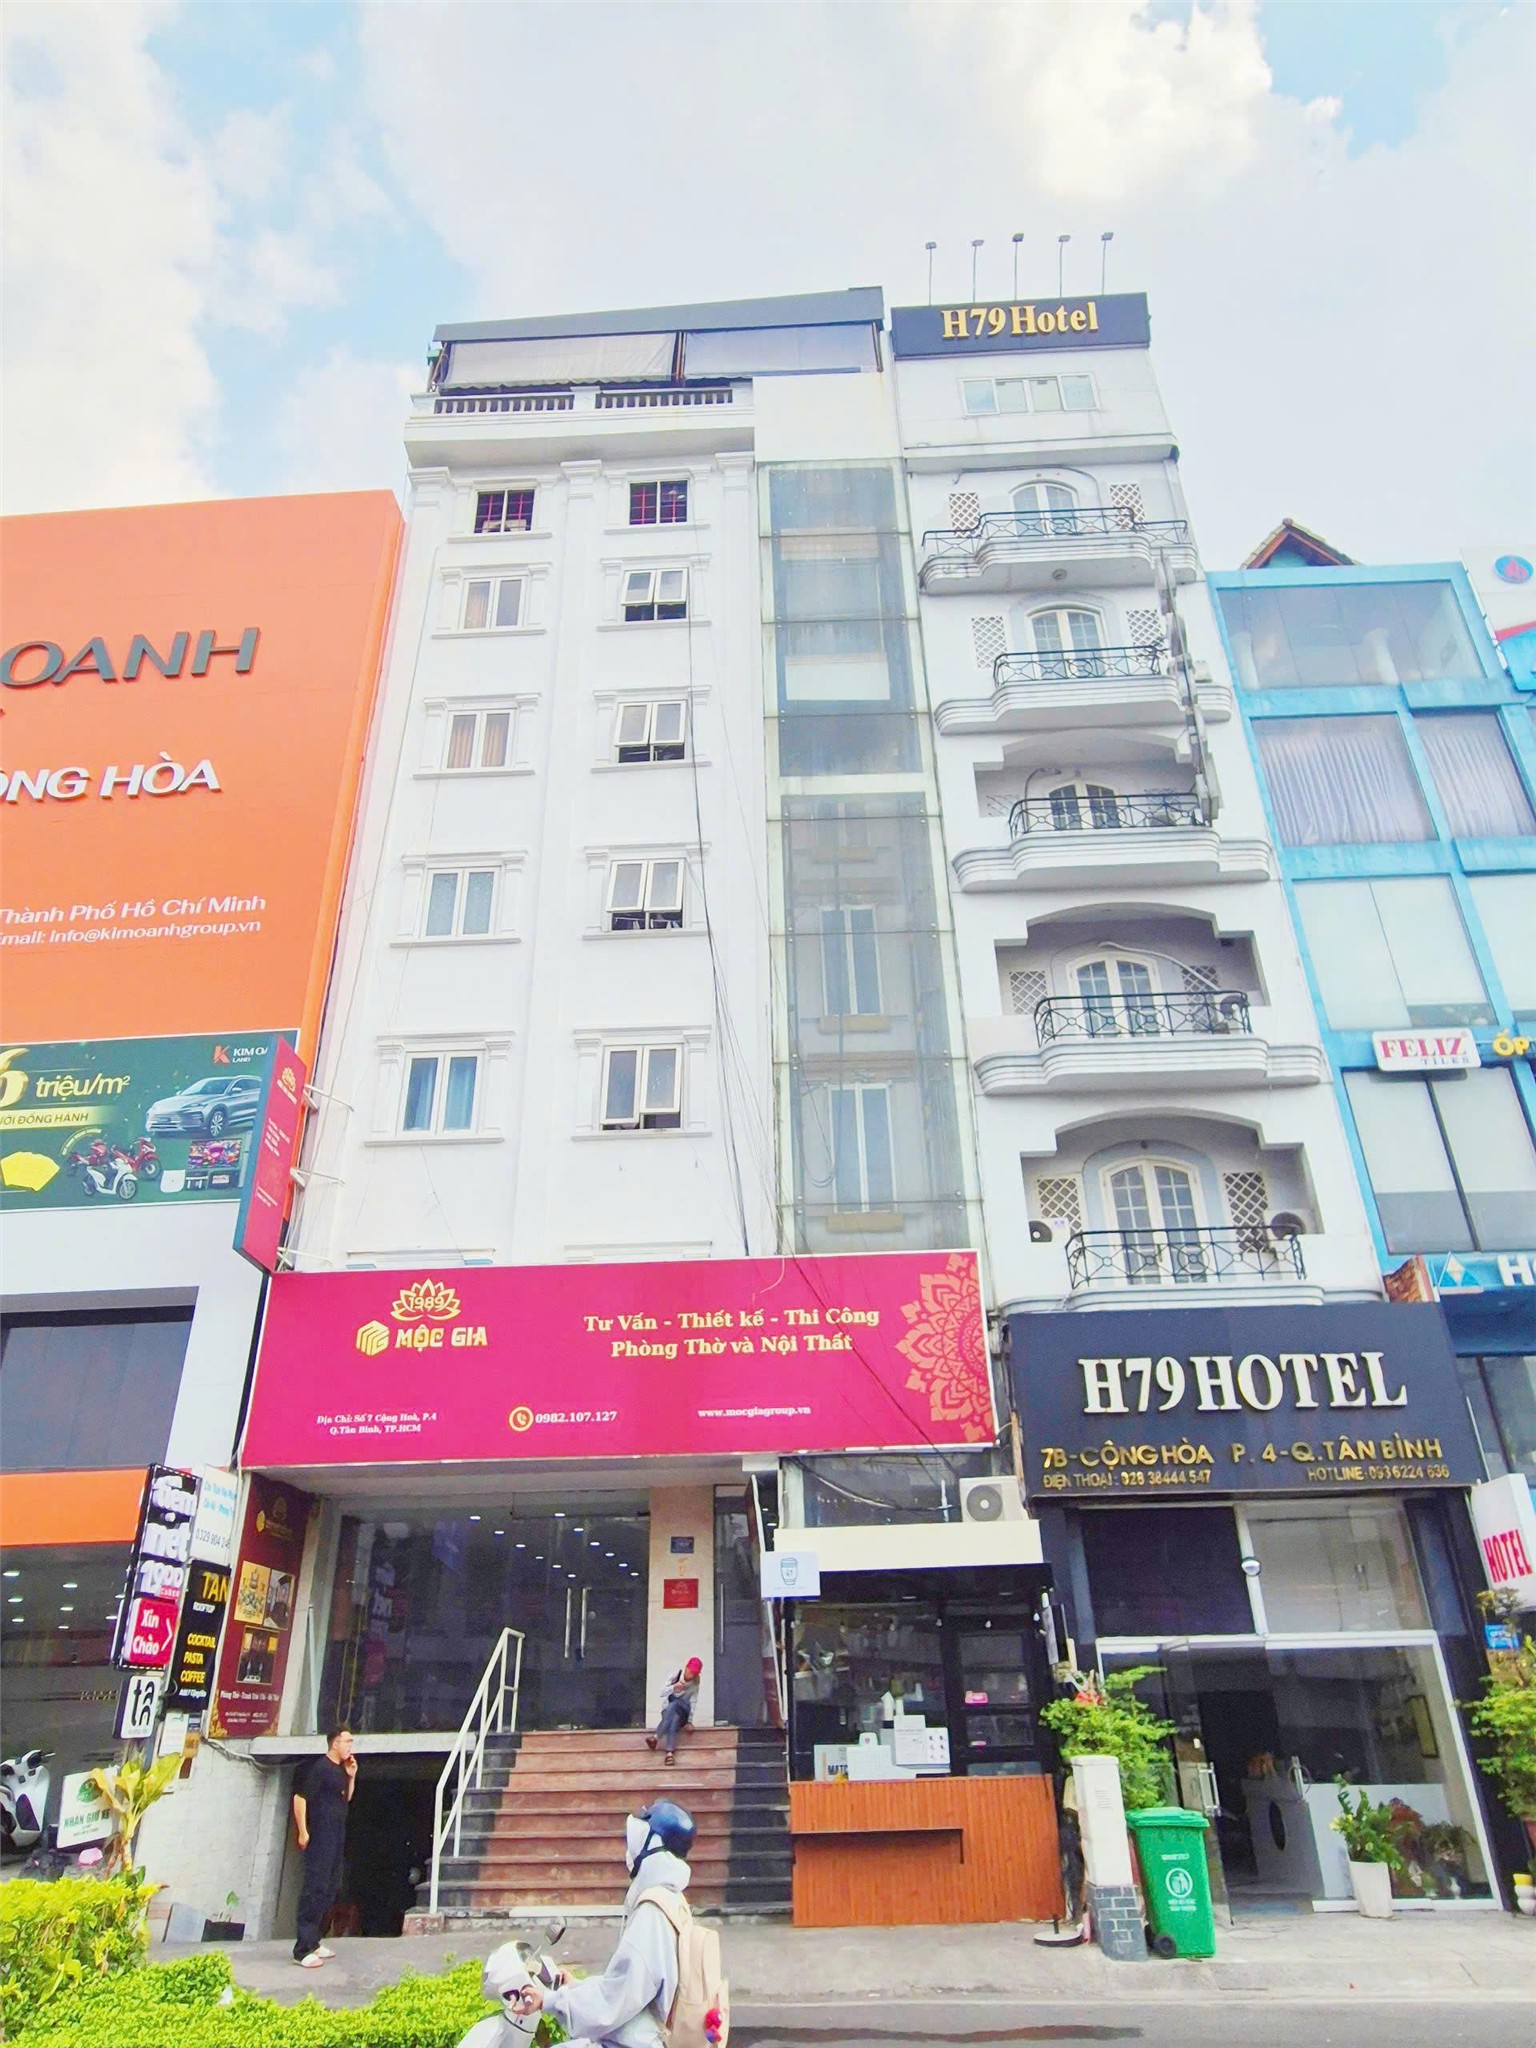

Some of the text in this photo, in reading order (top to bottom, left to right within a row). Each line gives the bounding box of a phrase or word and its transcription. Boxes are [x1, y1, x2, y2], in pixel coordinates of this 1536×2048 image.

[100, 751, 223, 798] HÒA
[70, 900, 117, 922] Phố
[121, 898, 156, 919] Hồ
[162, 897, 206, 916] Chí
[208, 895, 266, 914] Minh
[233, 1047, 255, 1057] KIM
[1381, 1036, 1467, 1058] FELIZ
[409, 1296, 445, 1309] 1989
[584, 1315, 613, 1331] Tư
[617, 1312, 658, 1330] Vấn
[678, 1309, 734, 1328] Thiết
[739, 1308, 765, 1327] kế
[784, 1308, 820, 1325] Thi
[825, 1306, 880, 1327] Công
[395, 1324, 488, 1352] MỘC GIA
[611, 1331, 853, 1360] Phòng Thờ và Nội Thất
[535, 1410, 618, 1424] 0982.107.127
[697, 1406, 811, 1418] www.mocgiagroup.vn
[1483, 1528, 1533, 1584] HOTEL
[141, 1608, 160, 1629] Xin
[132, 1633, 160, 1656] Chào
[183, 1651, 204, 1665] PASTA
[180, 1669, 207, 1684] COFFEE
